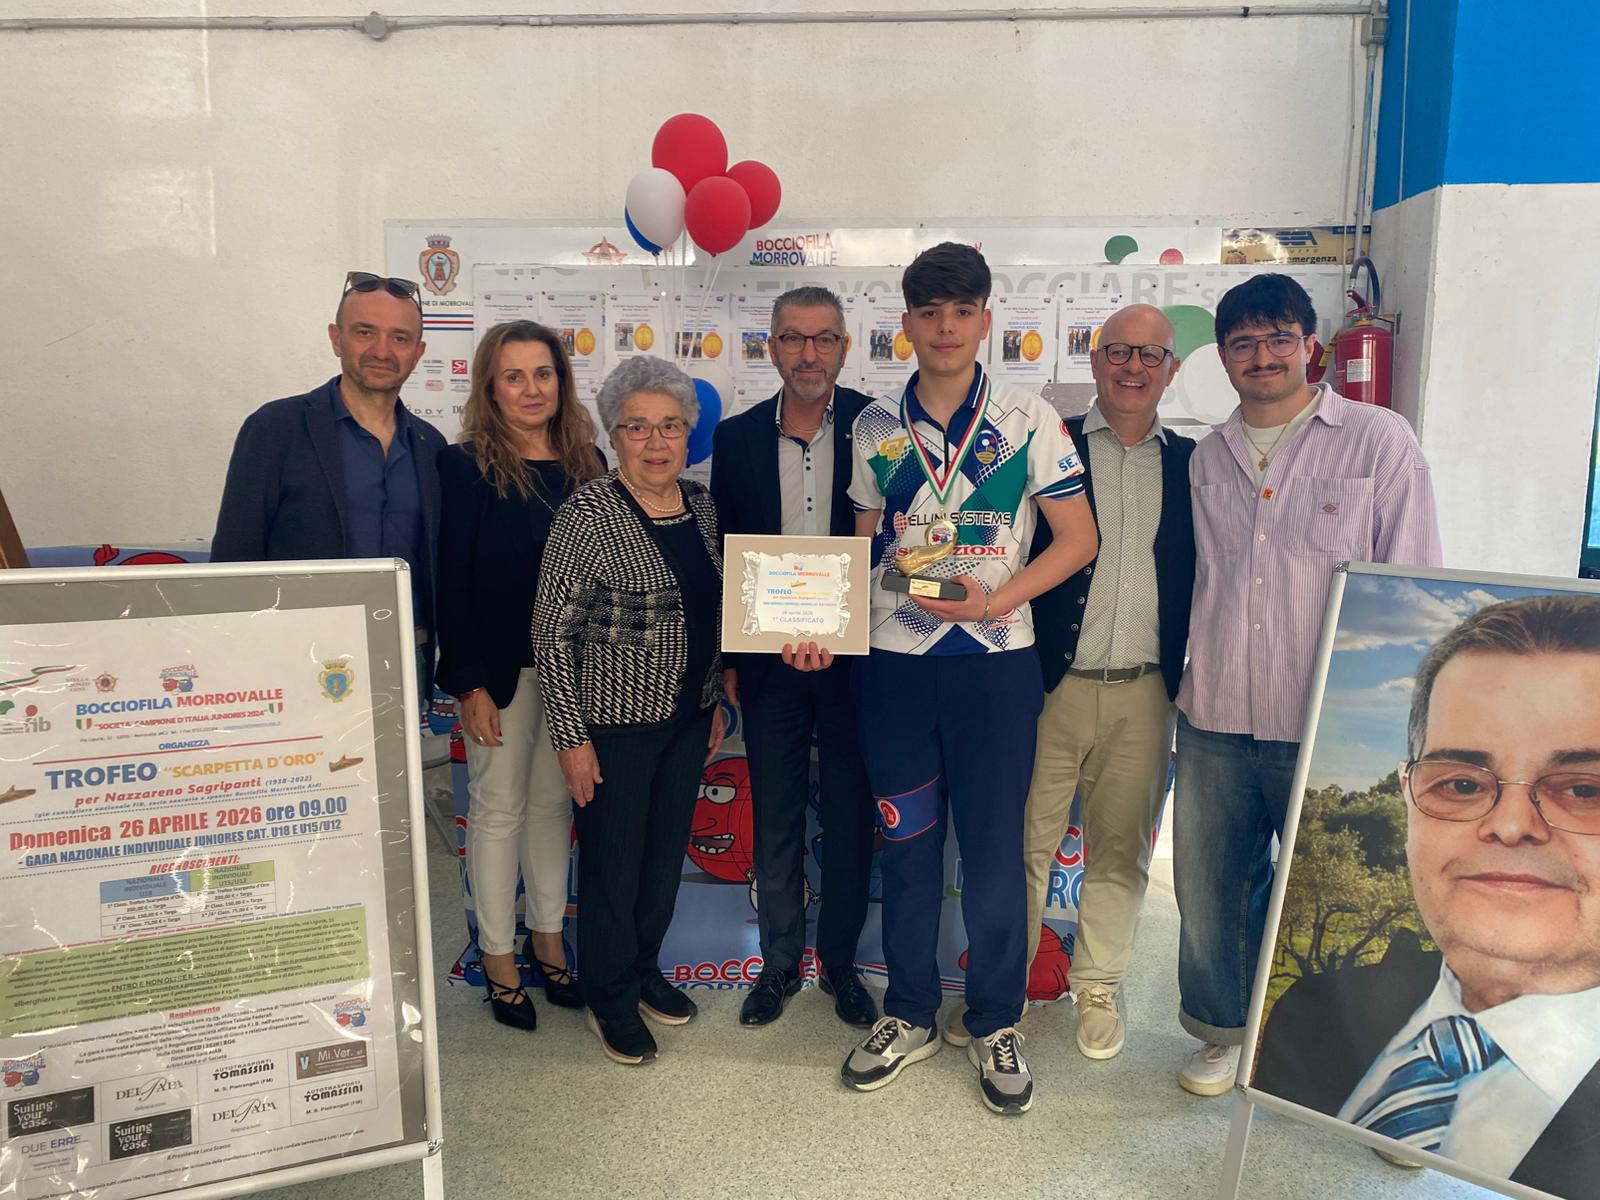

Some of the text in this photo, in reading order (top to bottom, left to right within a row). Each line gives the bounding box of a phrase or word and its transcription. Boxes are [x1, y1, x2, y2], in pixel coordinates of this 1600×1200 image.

[756, 232, 833, 252] BOCCIOFILA
[752, 251, 837, 266] MORROVALLE
[950, 511, 1011, 525] SYSTEMS
[780, 616, 824, 624] CLASSIFICATO
[76, 688, 283, 716] BOCCIOFILA MORROVALLE
[210, 711, 246, 721] JUNIORES
[158, 739, 210, 750] ORGANIZZA
[45, 762, 158, 790] TROFEO
[74, 796, 100, 808] per
[104, 788, 183, 803] Nazzareno
[187, 778, 262, 795] Sagripanti
[9, 796, 347, 851] Domenica 26 APRILE 2026 ore 09.00
[25, 819, 341, 867] GARA NAZIONALE INDIVIDUALE JUNIORES CAT. U18 E U15/U12
[111, 982, 137, 993] ENTRO
[145, 977, 163, 986] NON
[168, 1005, 221, 1020] Regolamento
[212, 1062, 275, 1081] TOMASSINI
[304, 1084, 363, 1103] TOMASSINI
[13, 1100, 54, 1115] Suiting
[17, 1110, 43, 1126] your
[21, 1117, 52, 1129] ease.
[114, 1121, 153, 1137] Suiting
[21, 1135, 81, 1154] DUE ERRE
[118, 1133, 143, 1148] your
[122, 1139, 152, 1152] ease.
